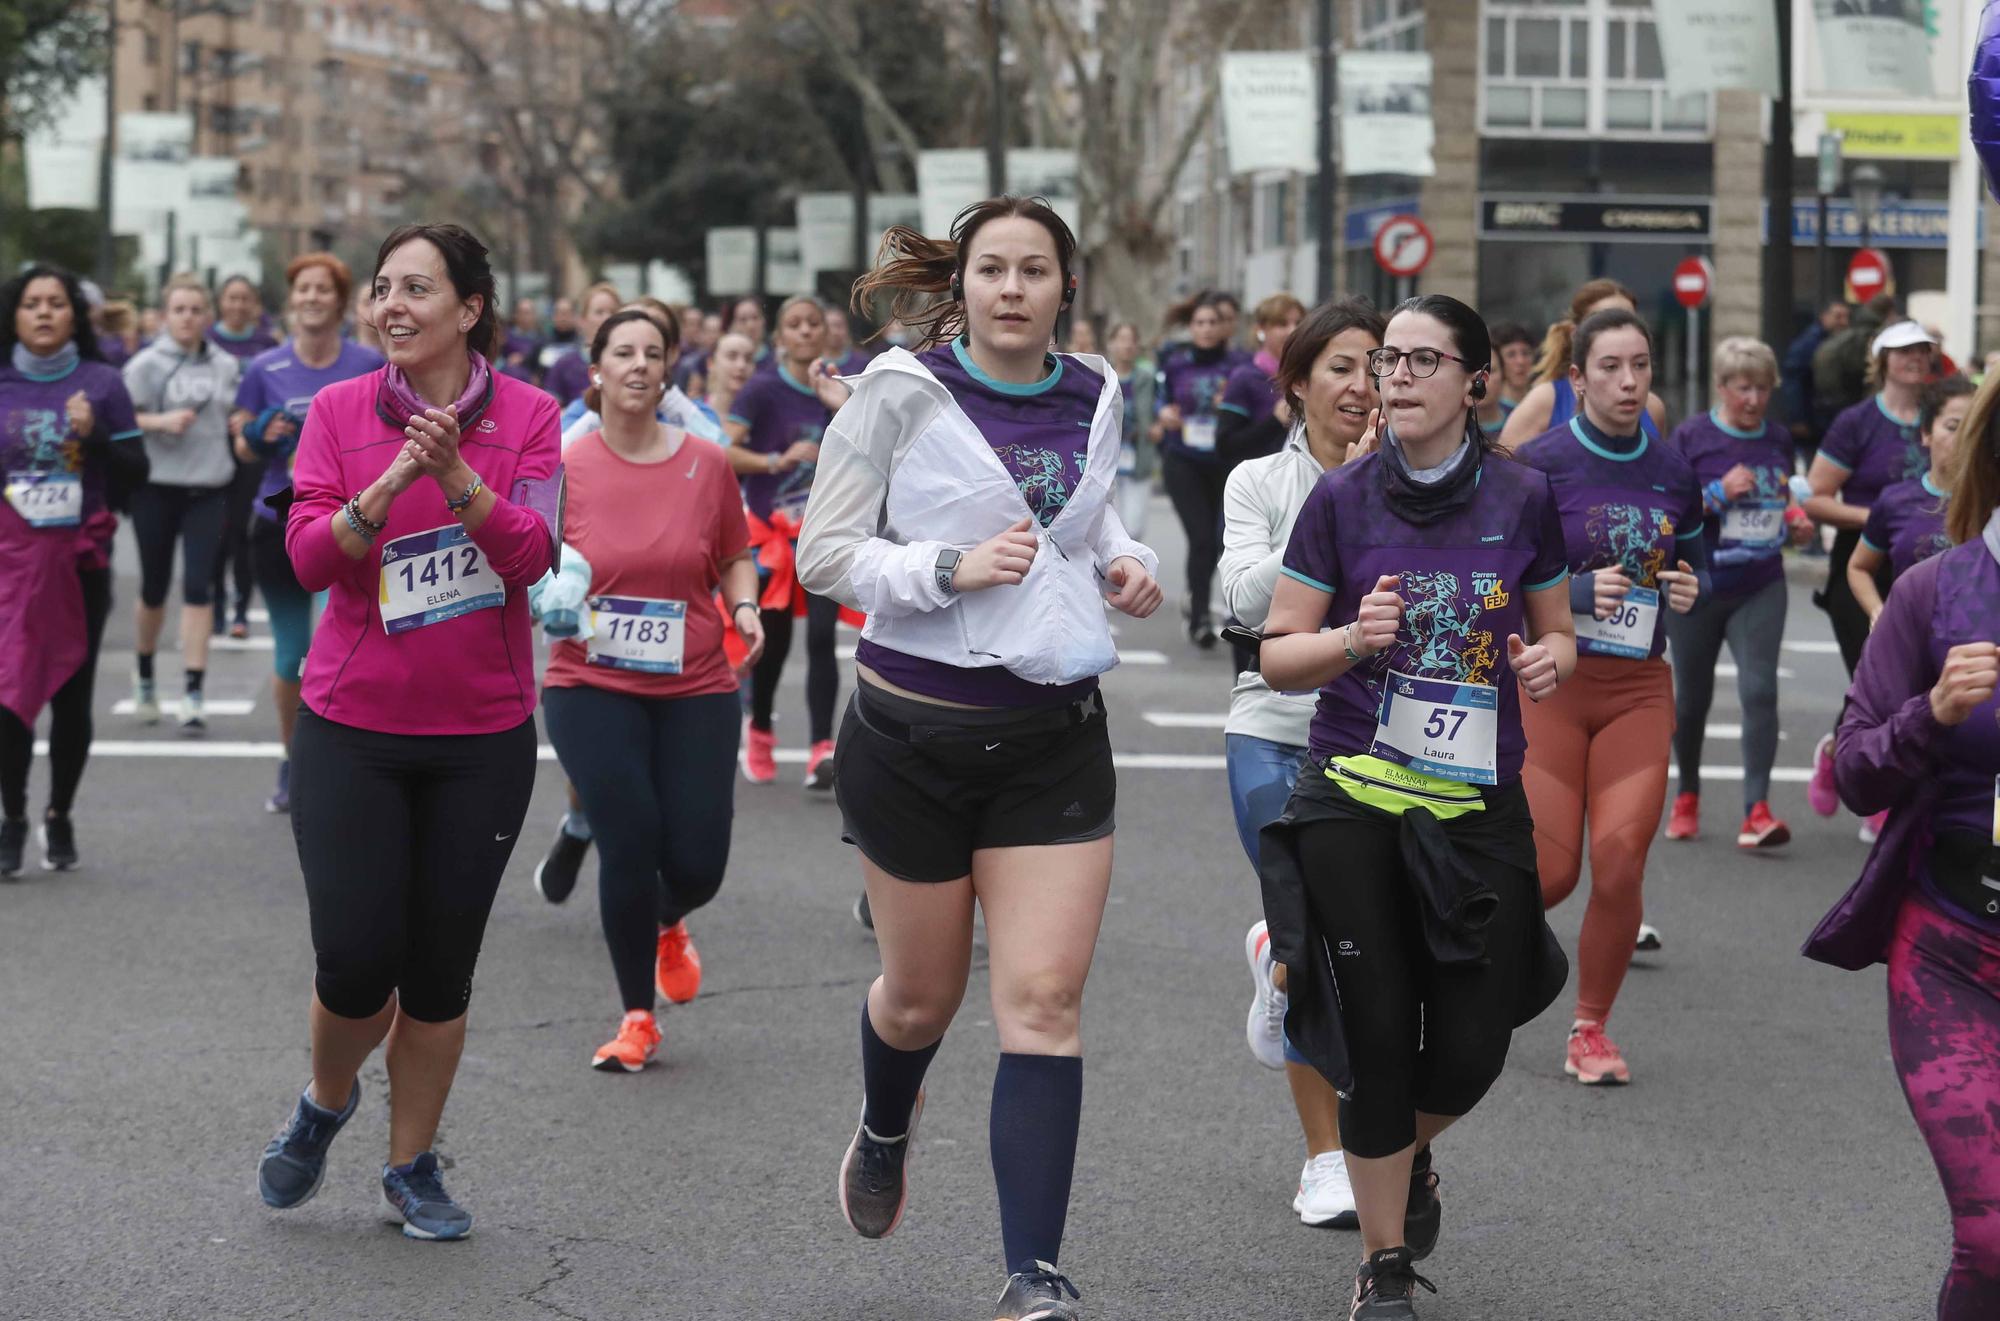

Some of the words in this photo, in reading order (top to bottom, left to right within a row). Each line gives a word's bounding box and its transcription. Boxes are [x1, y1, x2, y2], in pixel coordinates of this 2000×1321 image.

[400, 547, 479, 592] 1412
[1472, 578, 1503, 597] 10K
[427, 589, 461, 606] ELENA
[1486, 595, 1508, 609] FEM
[608, 617, 669, 644] 1183
[1423, 707, 1468, 741] 57
[1423, 746, 1455, 761] Laura
[1385, 768, 1394, 777] EL
